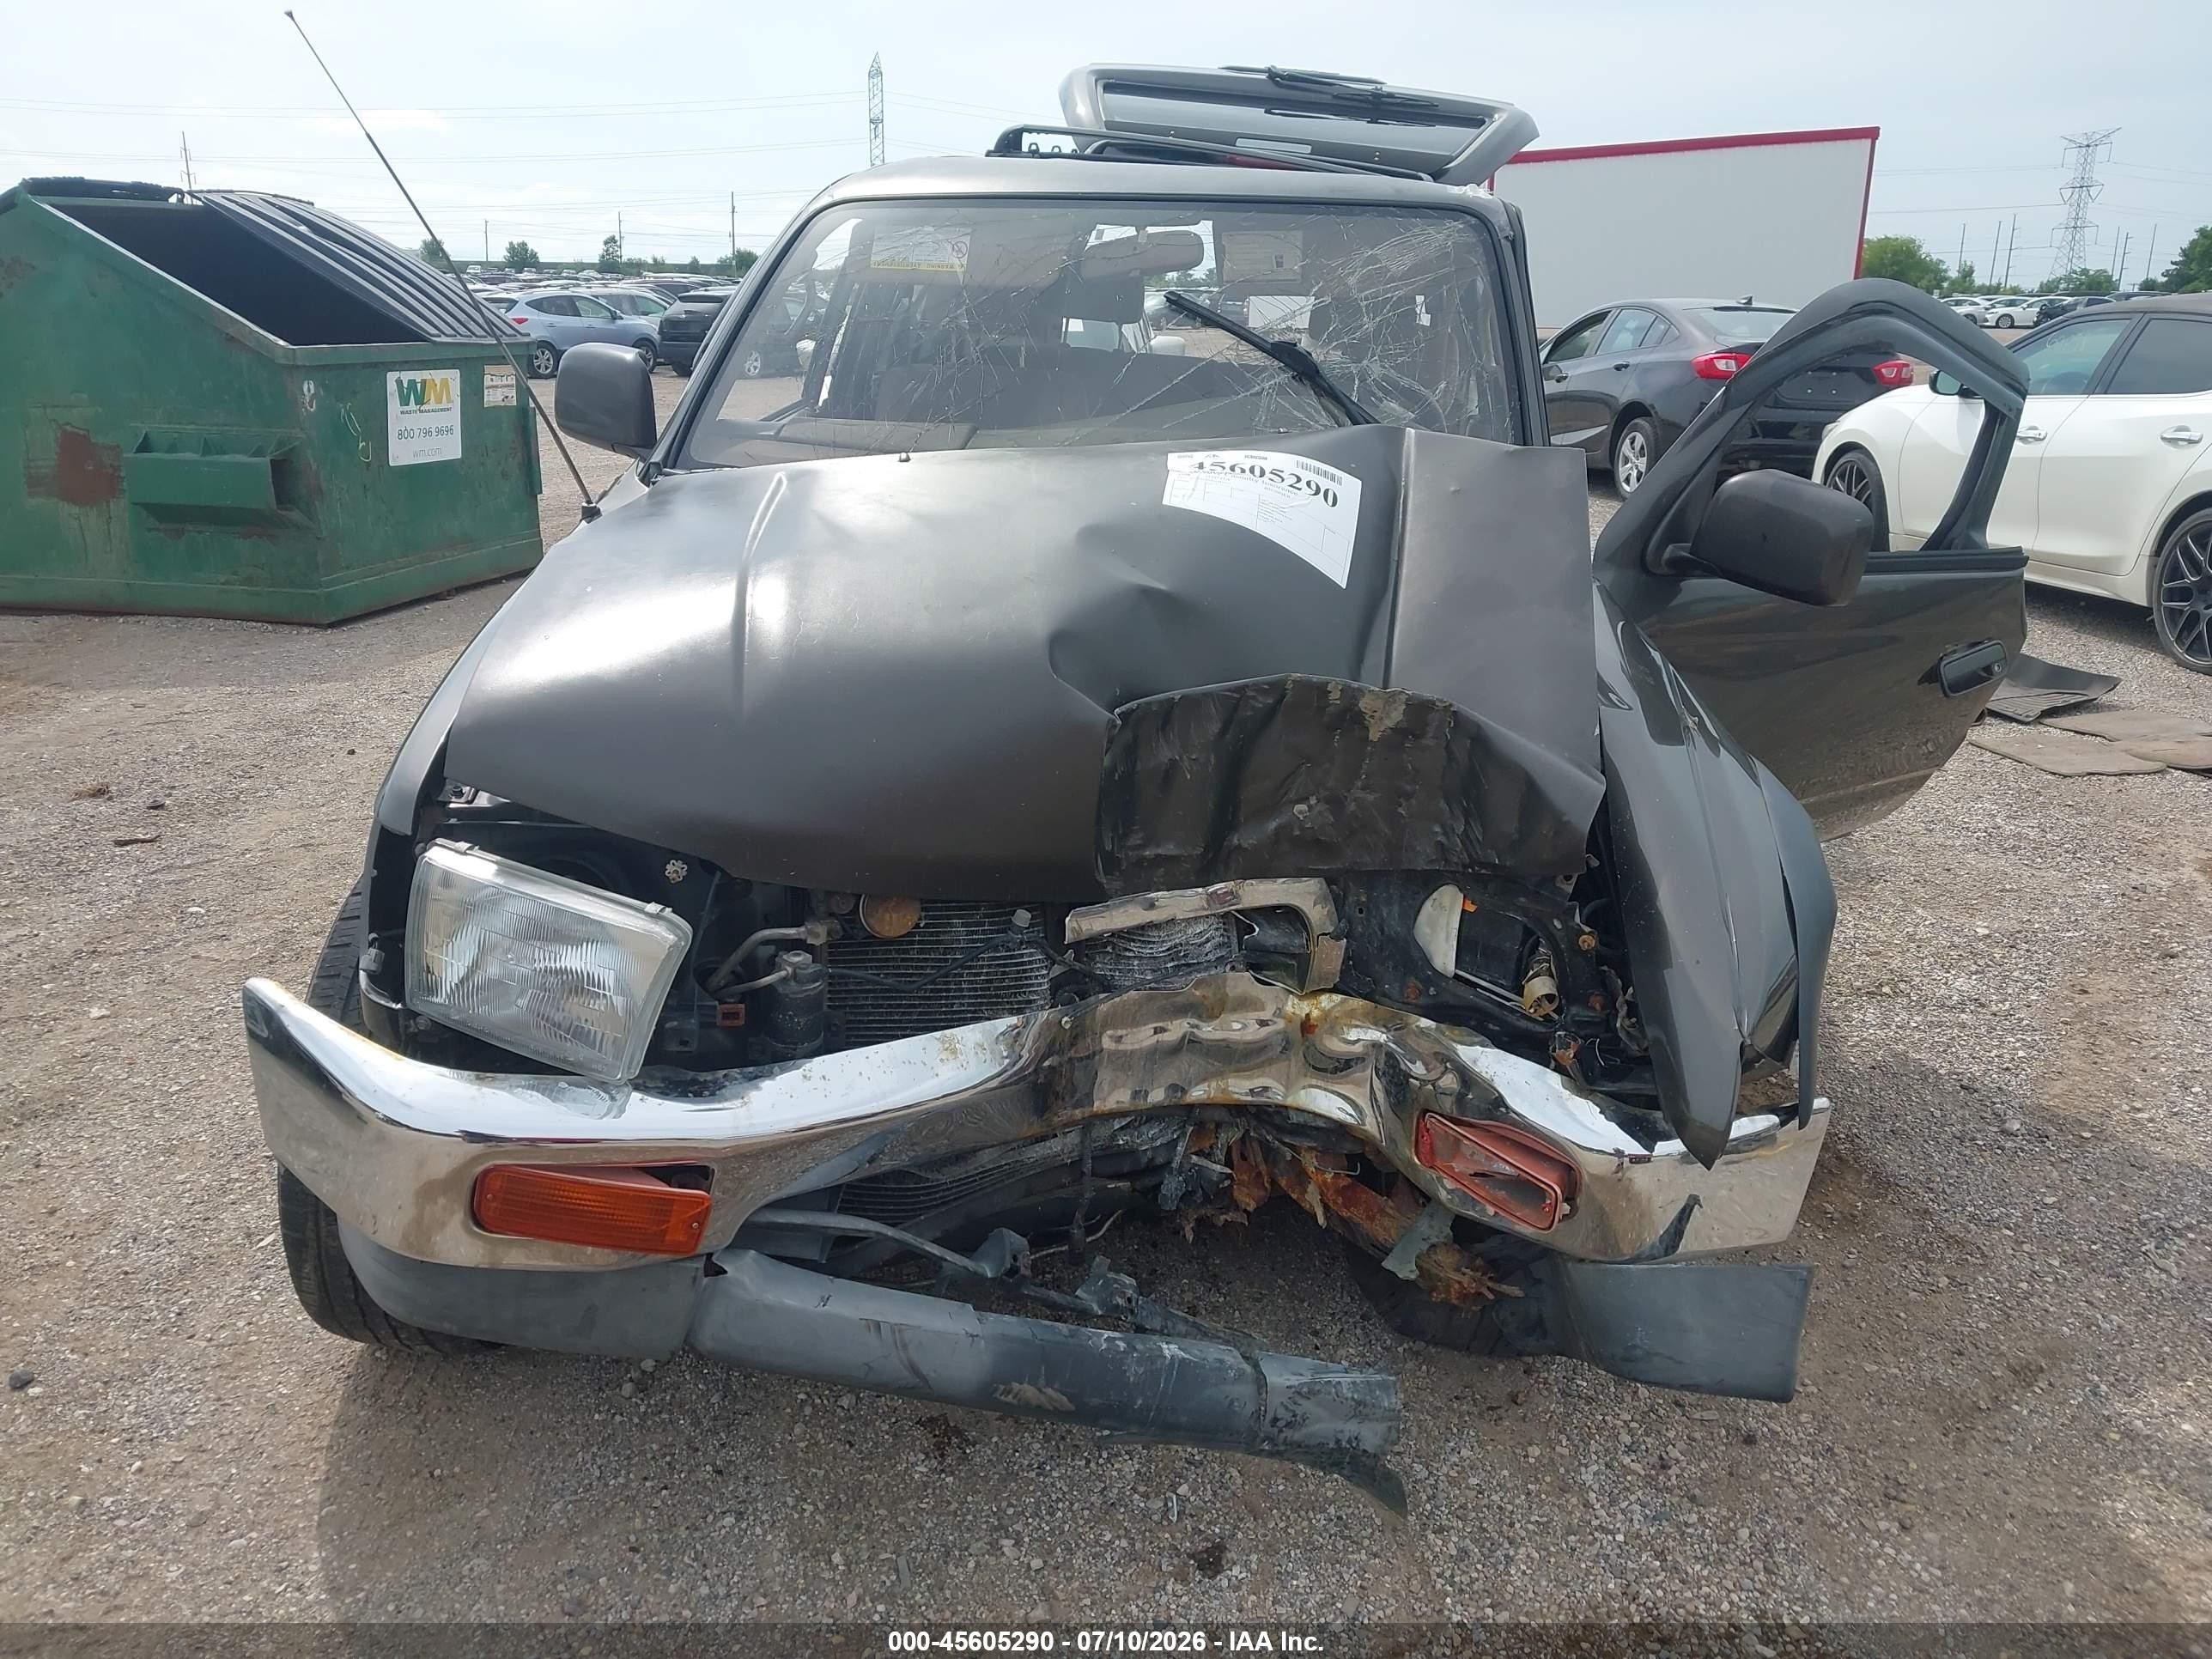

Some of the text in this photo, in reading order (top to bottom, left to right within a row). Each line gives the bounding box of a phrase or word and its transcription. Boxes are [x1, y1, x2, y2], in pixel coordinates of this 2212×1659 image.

[396, 378, 452, 406] WM
[397, 424, 454, 441] 800 796 9696
[412, 447, 442, 459] wm.com
[1190, 460, 1339, 508] 45605290
